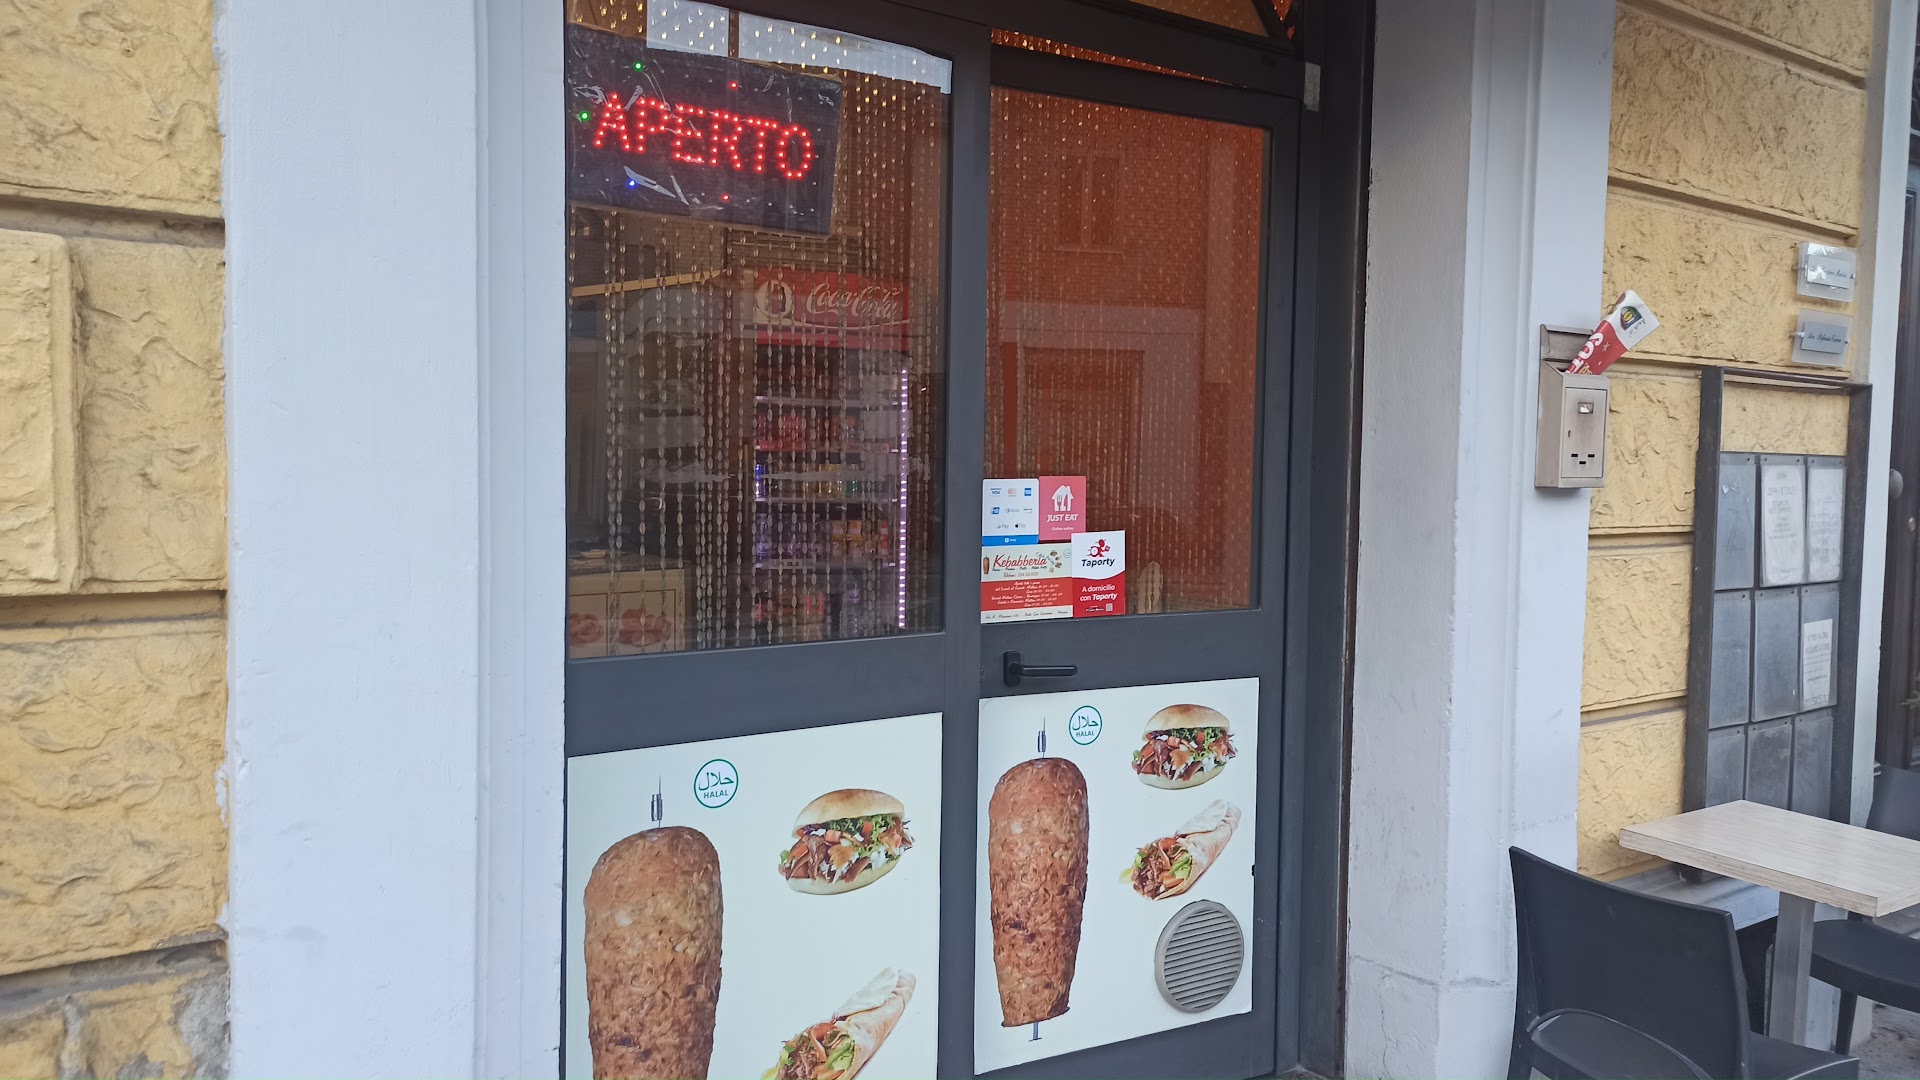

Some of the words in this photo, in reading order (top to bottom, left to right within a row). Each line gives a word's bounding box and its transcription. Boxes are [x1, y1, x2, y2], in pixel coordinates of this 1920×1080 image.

[593, 92, 816, 179] APERTO
[1565, 332, 1604, 374] SOT
[1047, 514, 1064, 522] JUST
[993, 554, 1047, 567] Kebabberia
[1081, 558, 1116, 568] Taporty
[1088, 584, 1116, 593] domicilio
[1092, 593, 1118, 602] Taporty
[698, 771, 735, 791] حلال
[703, 790, 729, 799] HALAL
